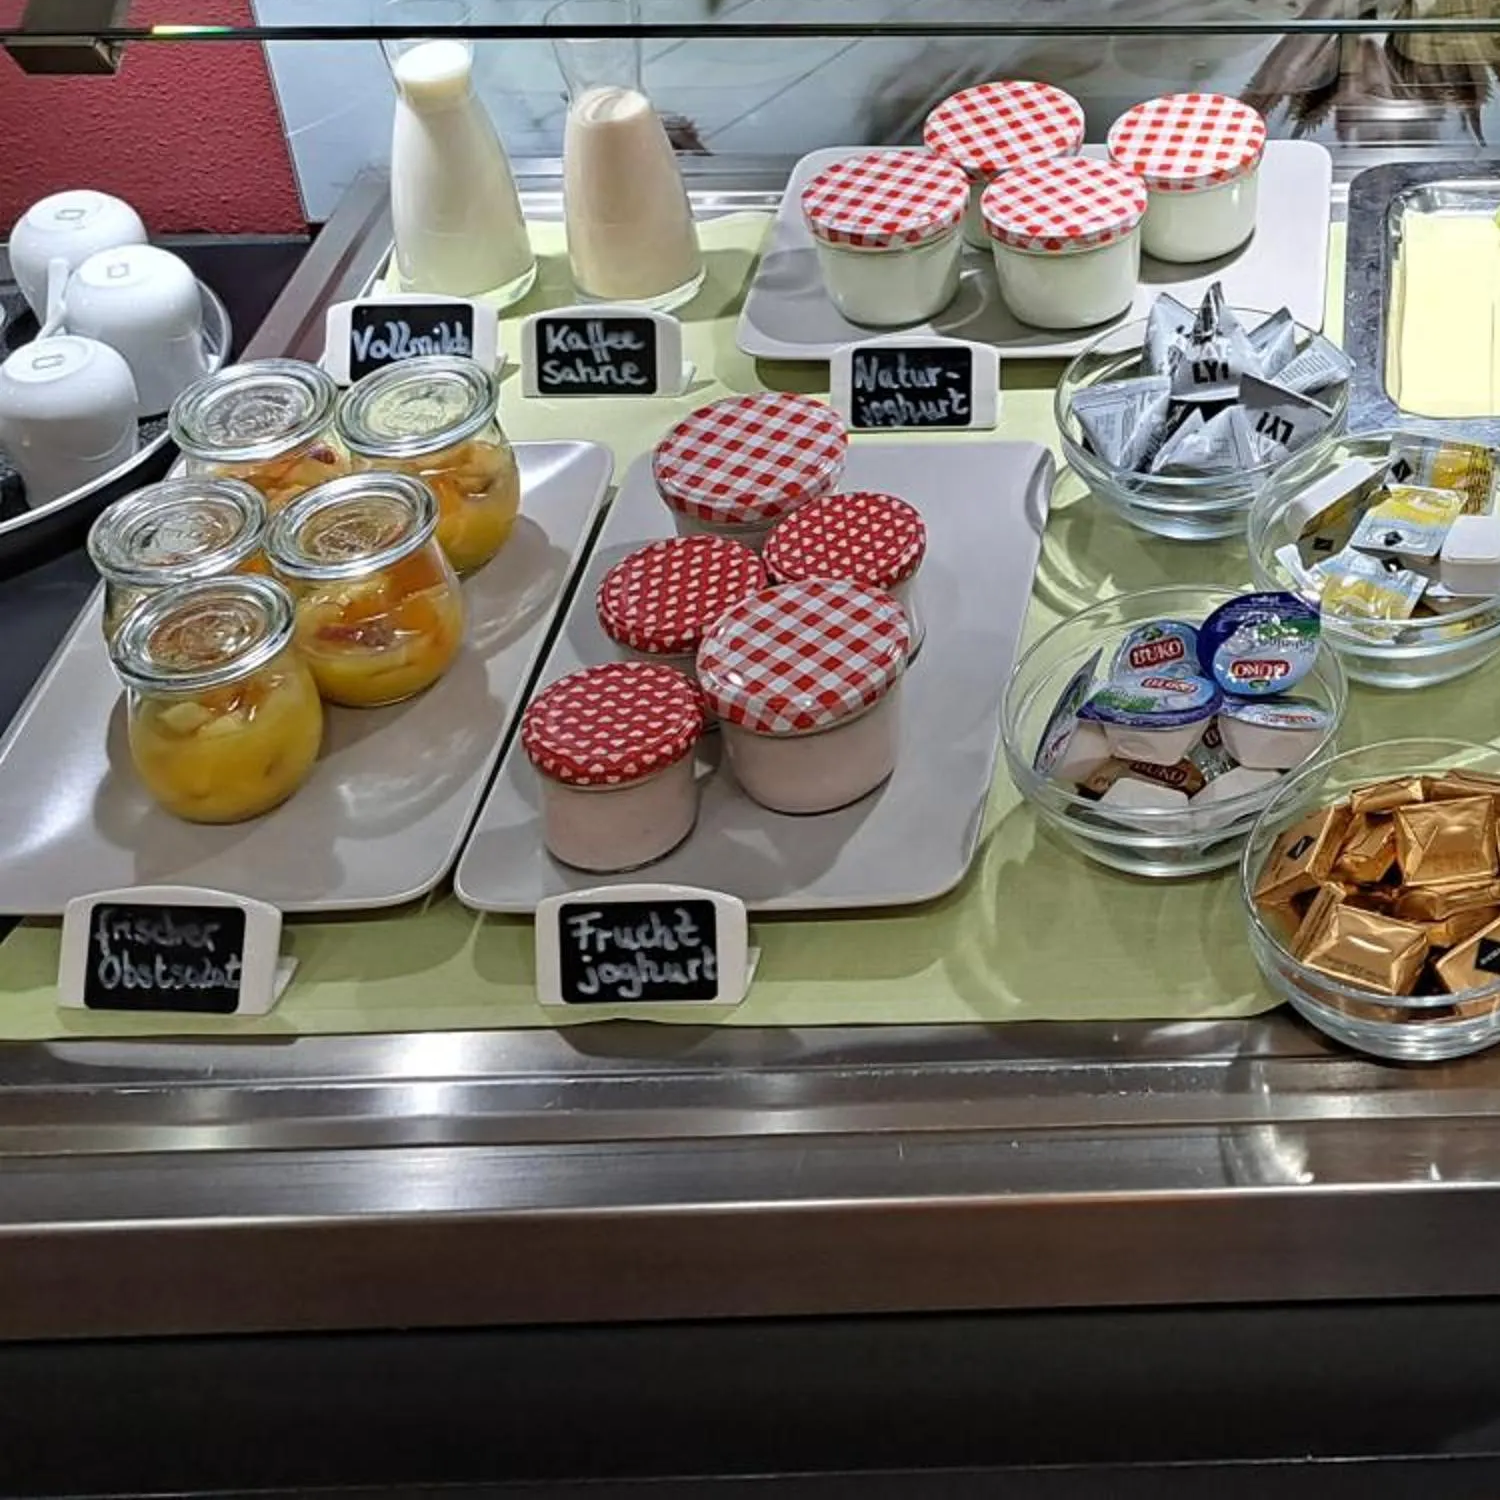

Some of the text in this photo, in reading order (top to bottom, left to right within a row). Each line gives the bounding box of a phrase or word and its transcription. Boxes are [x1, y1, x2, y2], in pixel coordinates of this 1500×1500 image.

[545, 321, 645, 363] Kaffee
[542, 360, 650, 386] Sahne
[567, 907, 702, 952] Frucht
[576, 945, 718, 998] joghurt
